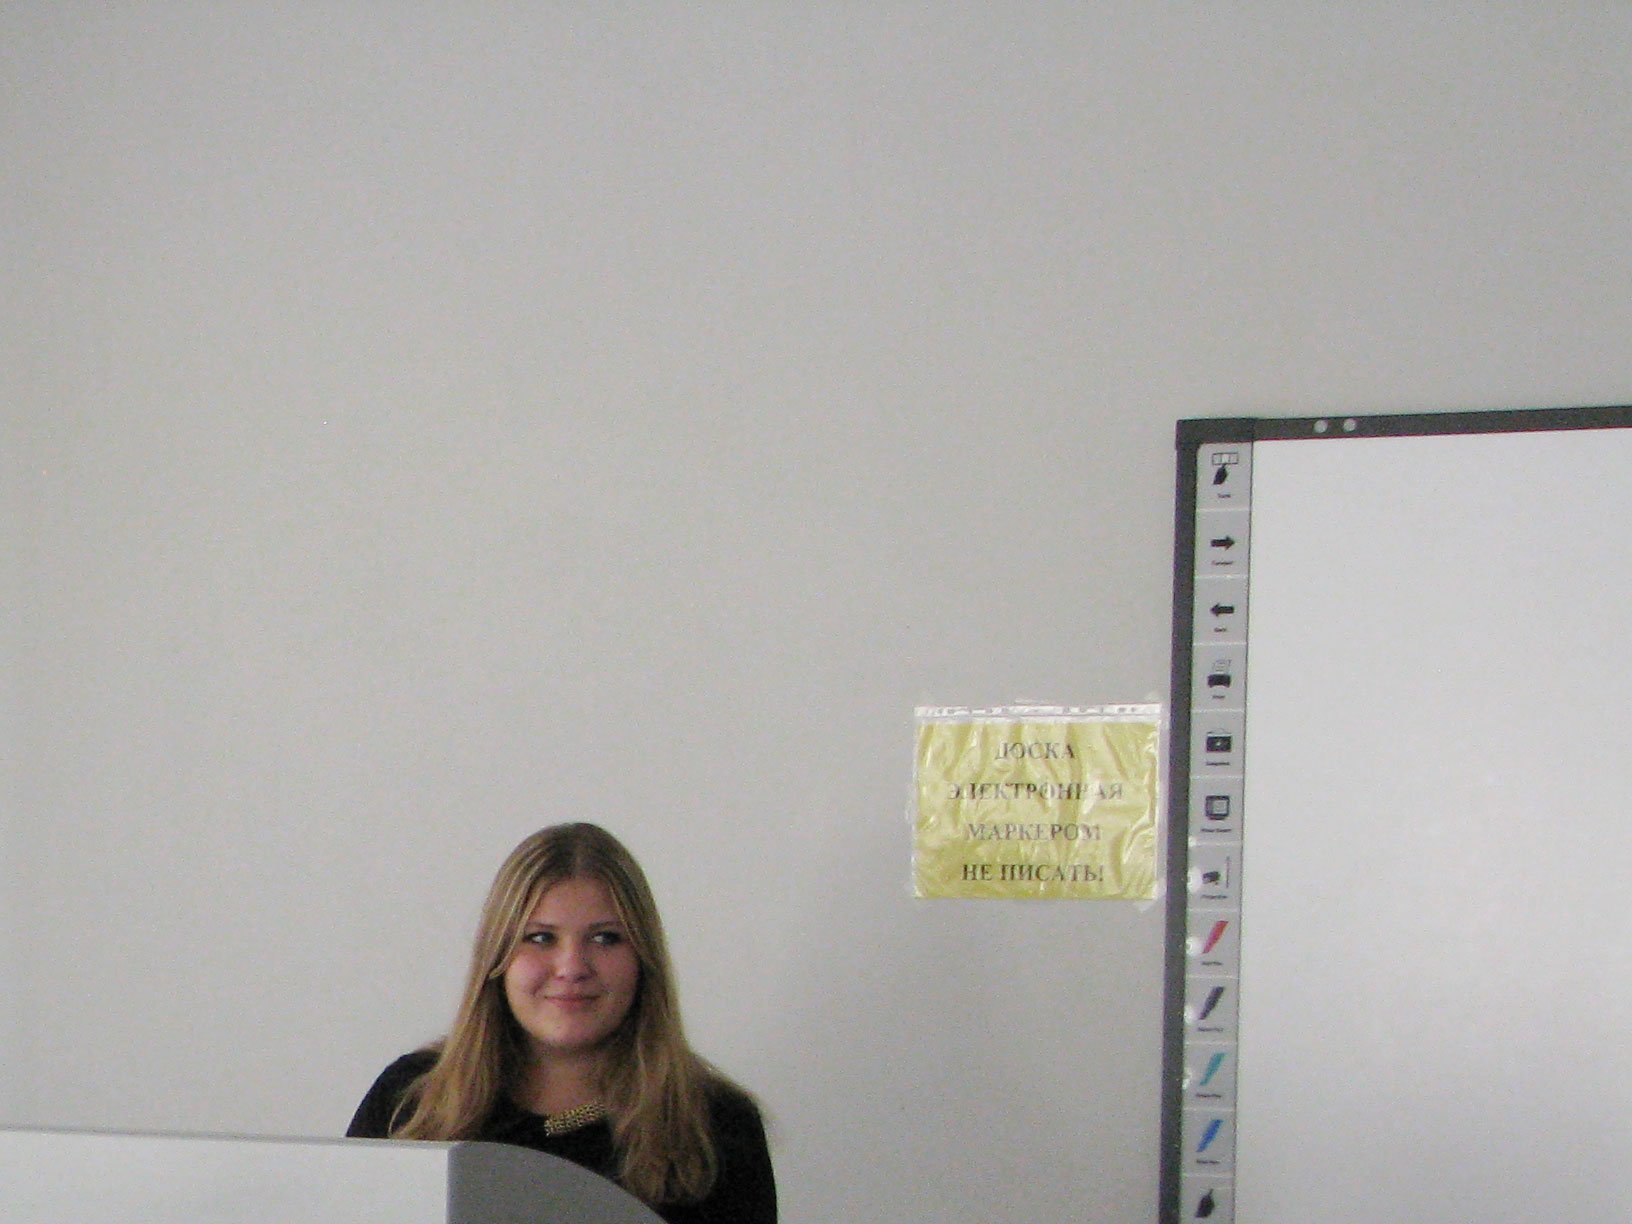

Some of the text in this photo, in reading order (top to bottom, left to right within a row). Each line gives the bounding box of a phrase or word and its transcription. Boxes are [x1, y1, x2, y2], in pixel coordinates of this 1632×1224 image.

[994, 742, 1076, 760] ДОСКА
[965, 823, 1101, 841] МАРКЕРОМ
[962, 864, 1105, 882] НЕ ПИСАТЬ!
